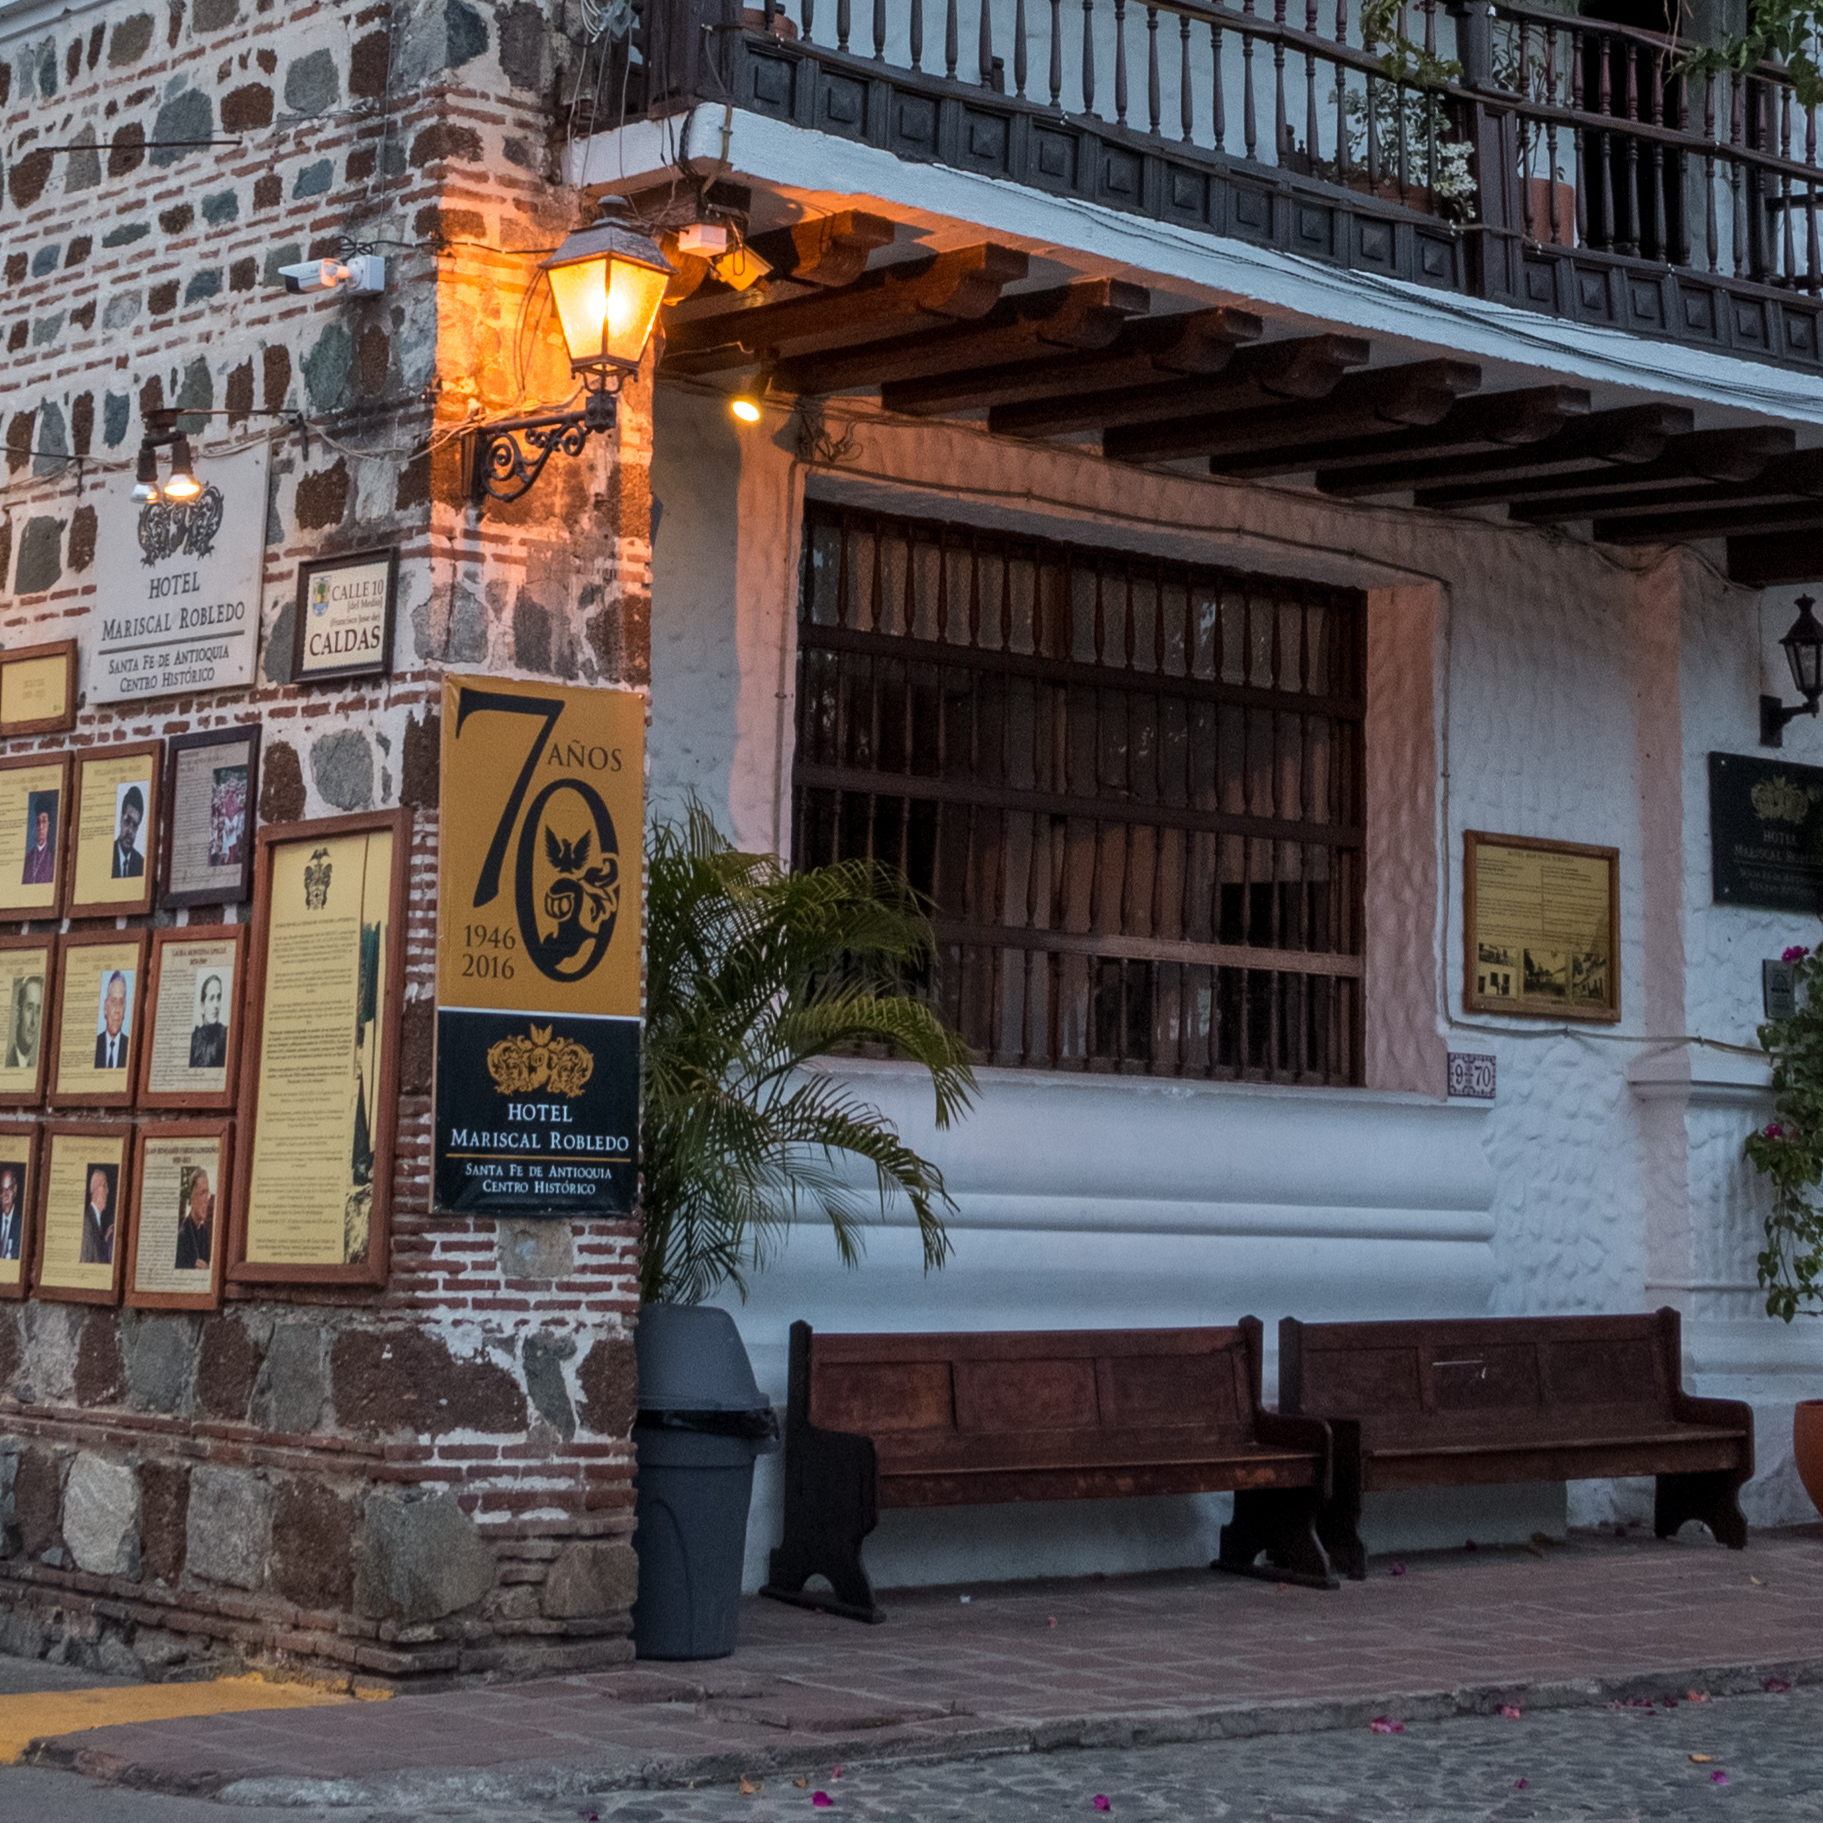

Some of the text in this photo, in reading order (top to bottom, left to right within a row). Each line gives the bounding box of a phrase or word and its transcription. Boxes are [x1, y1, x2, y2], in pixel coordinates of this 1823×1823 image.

[148, 571, 201, 599] HOTEL
[331, 579, 384, 602] CALLE 10
[101, 601, 246, 642] MARISCAL ROBLEDO
[309, 625, 381, 657] CALDAS
[108, 644, 230, 675] SANTA FE DE ANTIOQUIA
[120, 666, 216, 694] CENTRO HISTÓRICO
[547, 739, 623, 772] AÑOS
[463, 923, 516, 951] 1946
[462, 953, 515, 980] 2016
[507, 1103, 573, 1123] HOTEL
[450, 1129, 630, 1152] MARISCAL ROBLEDO
[465, 1163, 612, 1180] SANTA FE DE ANTIOQUIA
[482, 1179, 596, 1196] CENTRO HISTÓRICO
